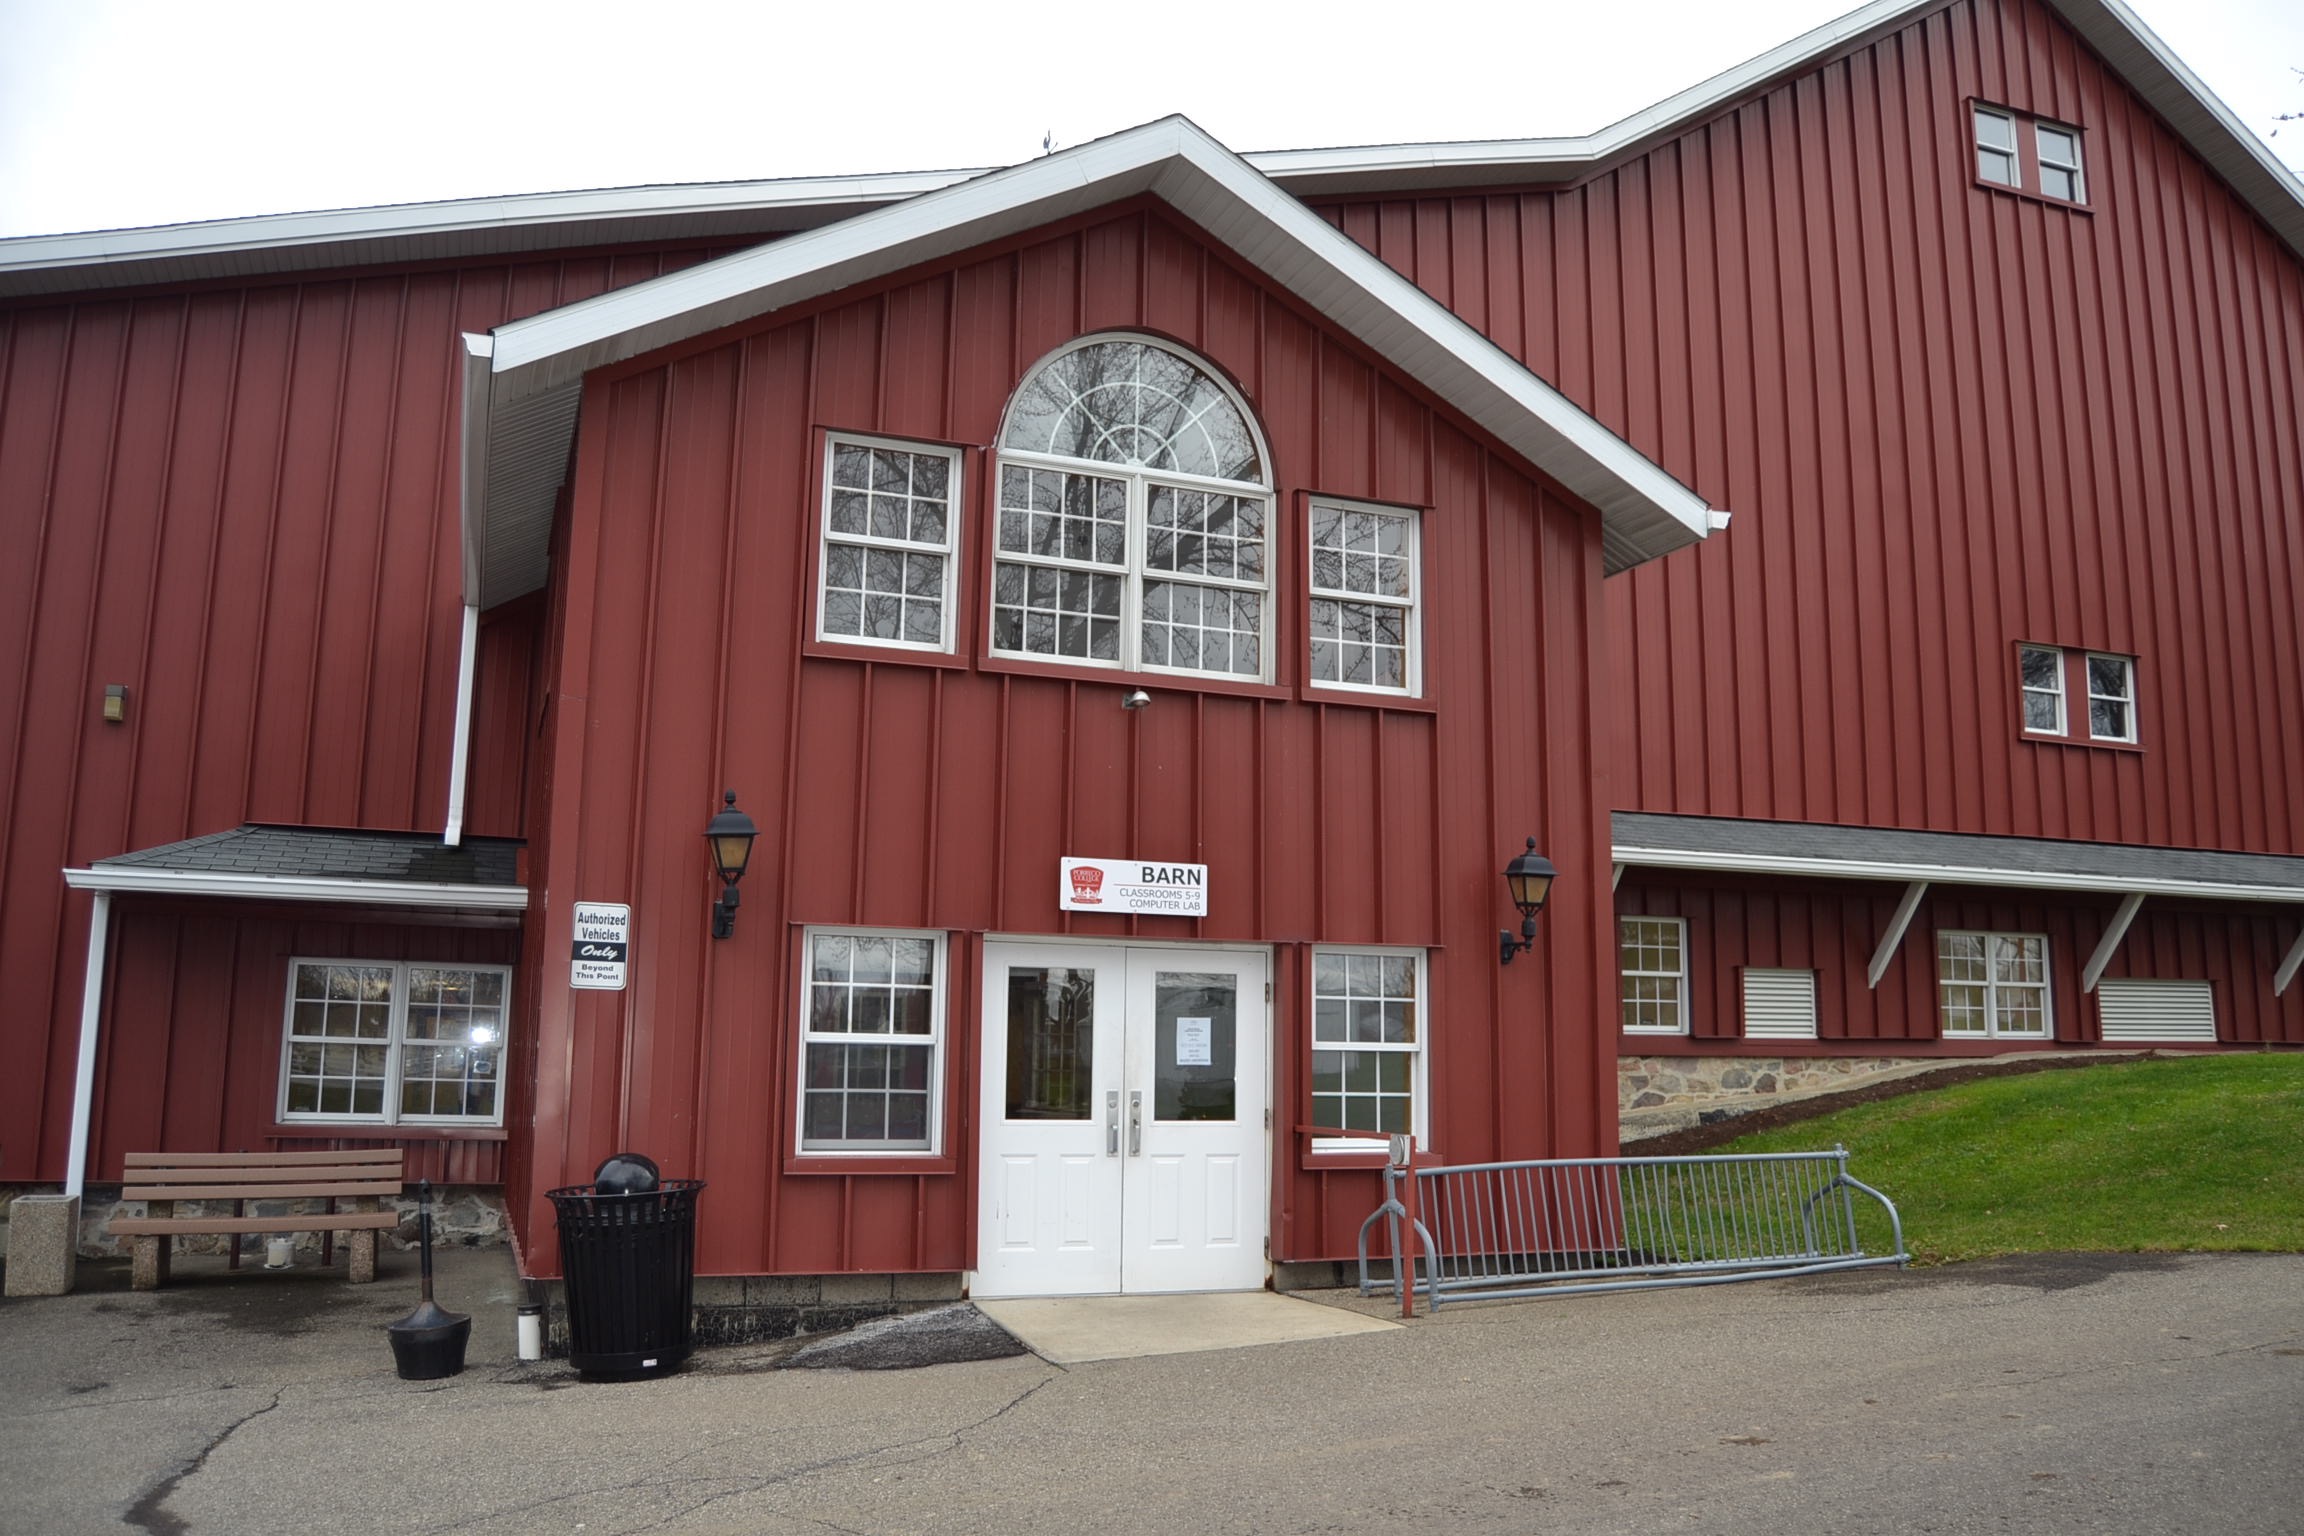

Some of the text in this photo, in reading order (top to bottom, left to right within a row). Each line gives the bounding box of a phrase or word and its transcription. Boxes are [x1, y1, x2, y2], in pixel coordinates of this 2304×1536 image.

[1142, 866, 1201, 886] BARN
[1120, 888, 1200, 900] CLASSROOMS 5-9
[1129, 899, 1200, 910] COMPUTER LAB
[577, 912, 626, 925] Authorized
[582, 927, 620, 941] Vehicles
[581, 944, 618, 960] Only
[581, 964, 614, 972] Beyond
